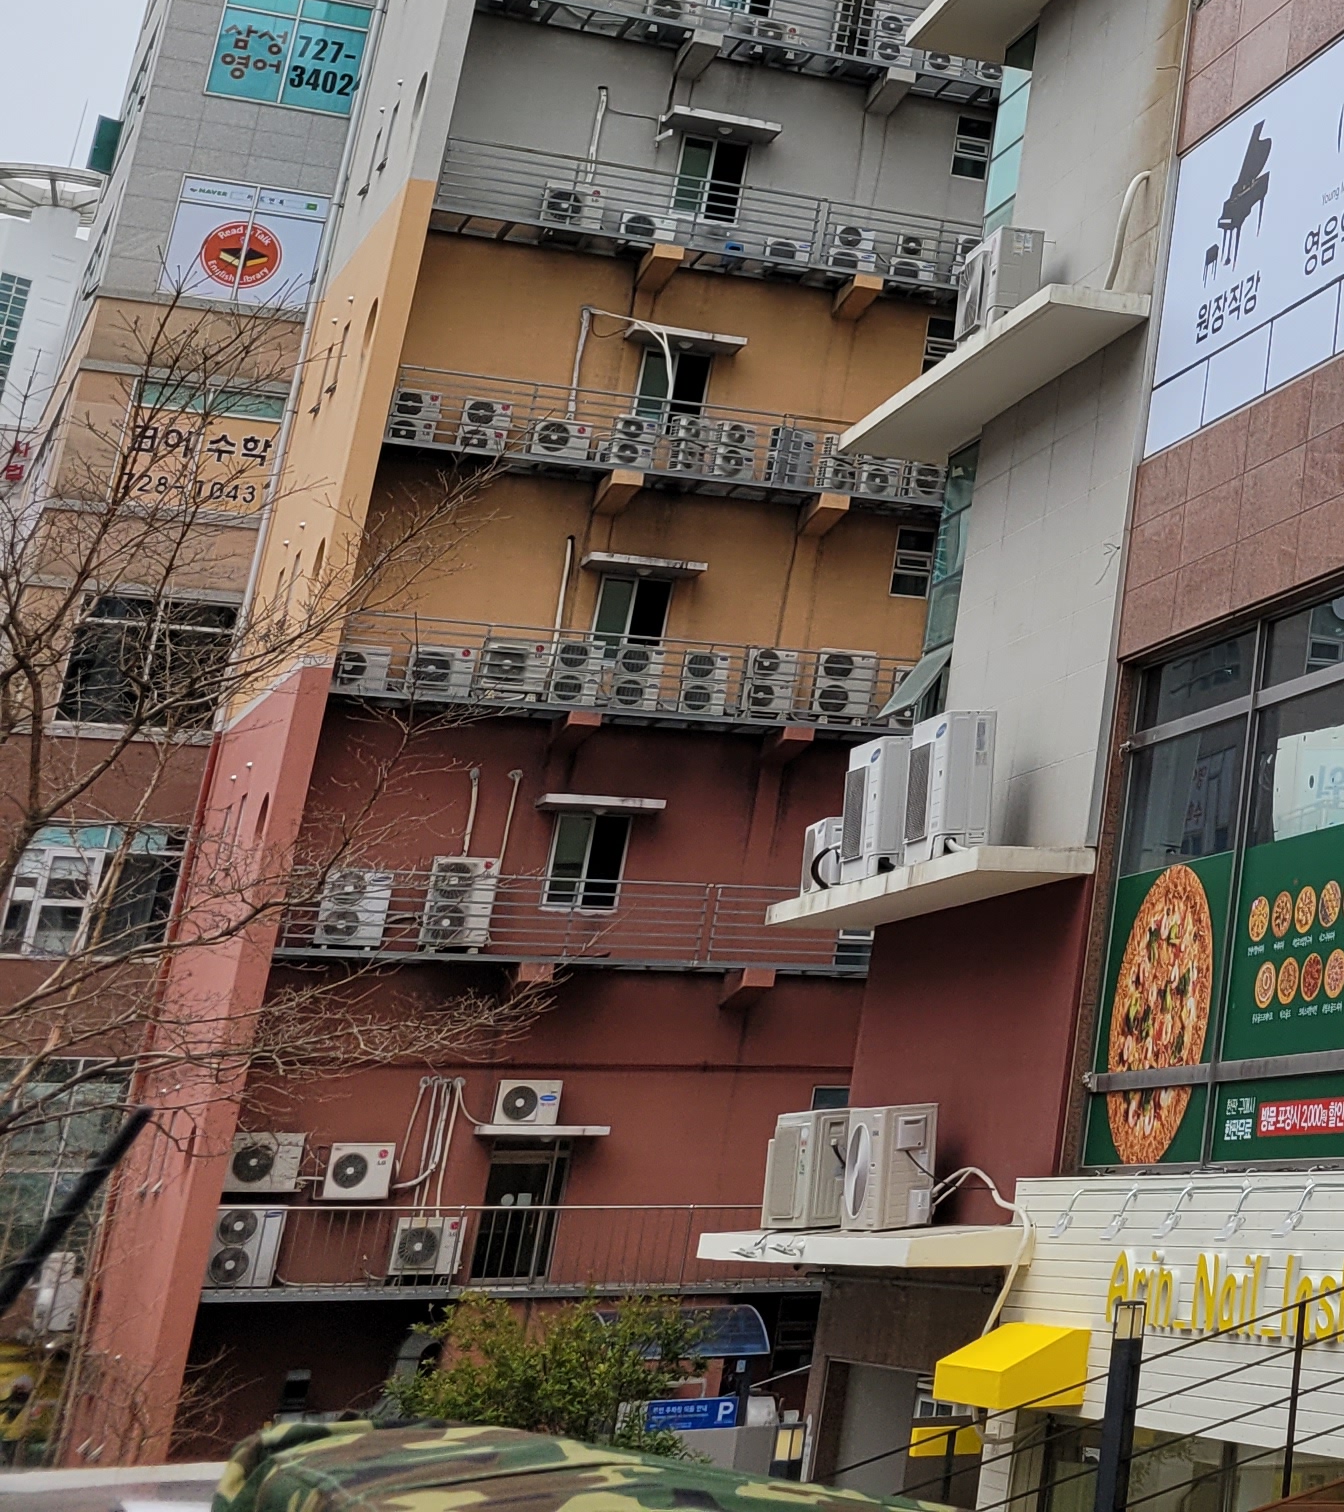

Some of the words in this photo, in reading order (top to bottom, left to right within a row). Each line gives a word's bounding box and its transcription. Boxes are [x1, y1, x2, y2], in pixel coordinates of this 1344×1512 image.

[224, 23, 289, 56] 삼성
[220, 52, 282, 80] 영어
[199, 188, 227, 197] NAVER
[218, 226, 244, 239] Read
[254, 228, 271, 246] Talk
[208, 260, 235, 282] English
[1195, 271, 1261, 345] 원장직강
[207, 434, 272, 467] 수학
[1259, 1104, 1276, 1131] 방문
[1276, 1102, 1301, 1129] 포장시
[717, 1401, 734, 1421] P
